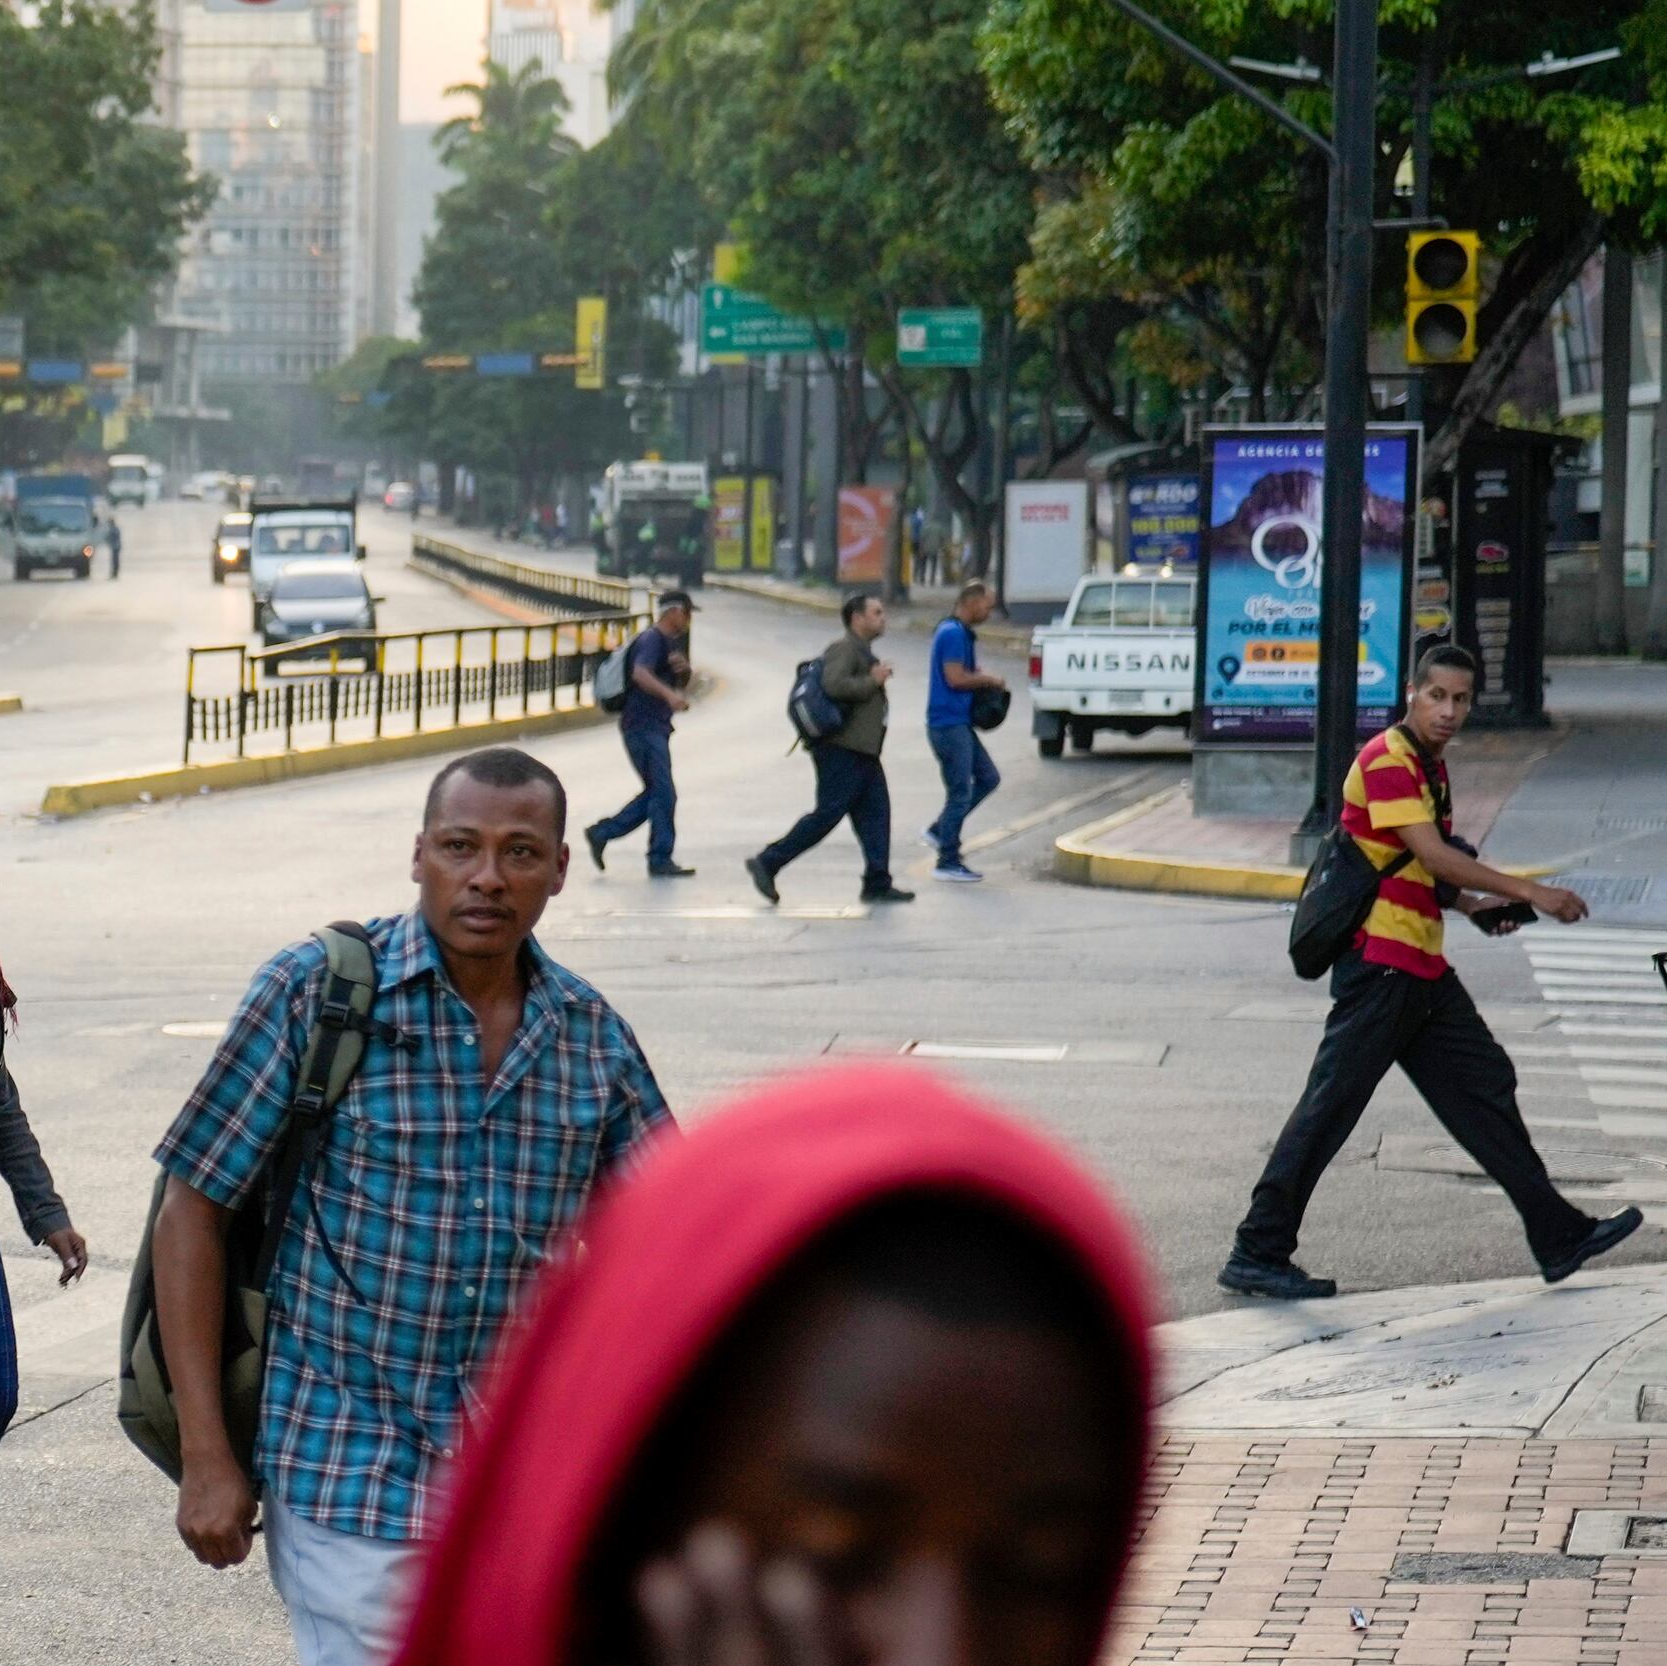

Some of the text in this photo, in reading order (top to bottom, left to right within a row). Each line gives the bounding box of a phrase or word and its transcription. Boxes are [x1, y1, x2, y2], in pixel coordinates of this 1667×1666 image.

[1228, 622, 1266, 636] POR
[1271, 622, 1293, 636] EL
[1067, 653, 1190, 672] NISSAN
